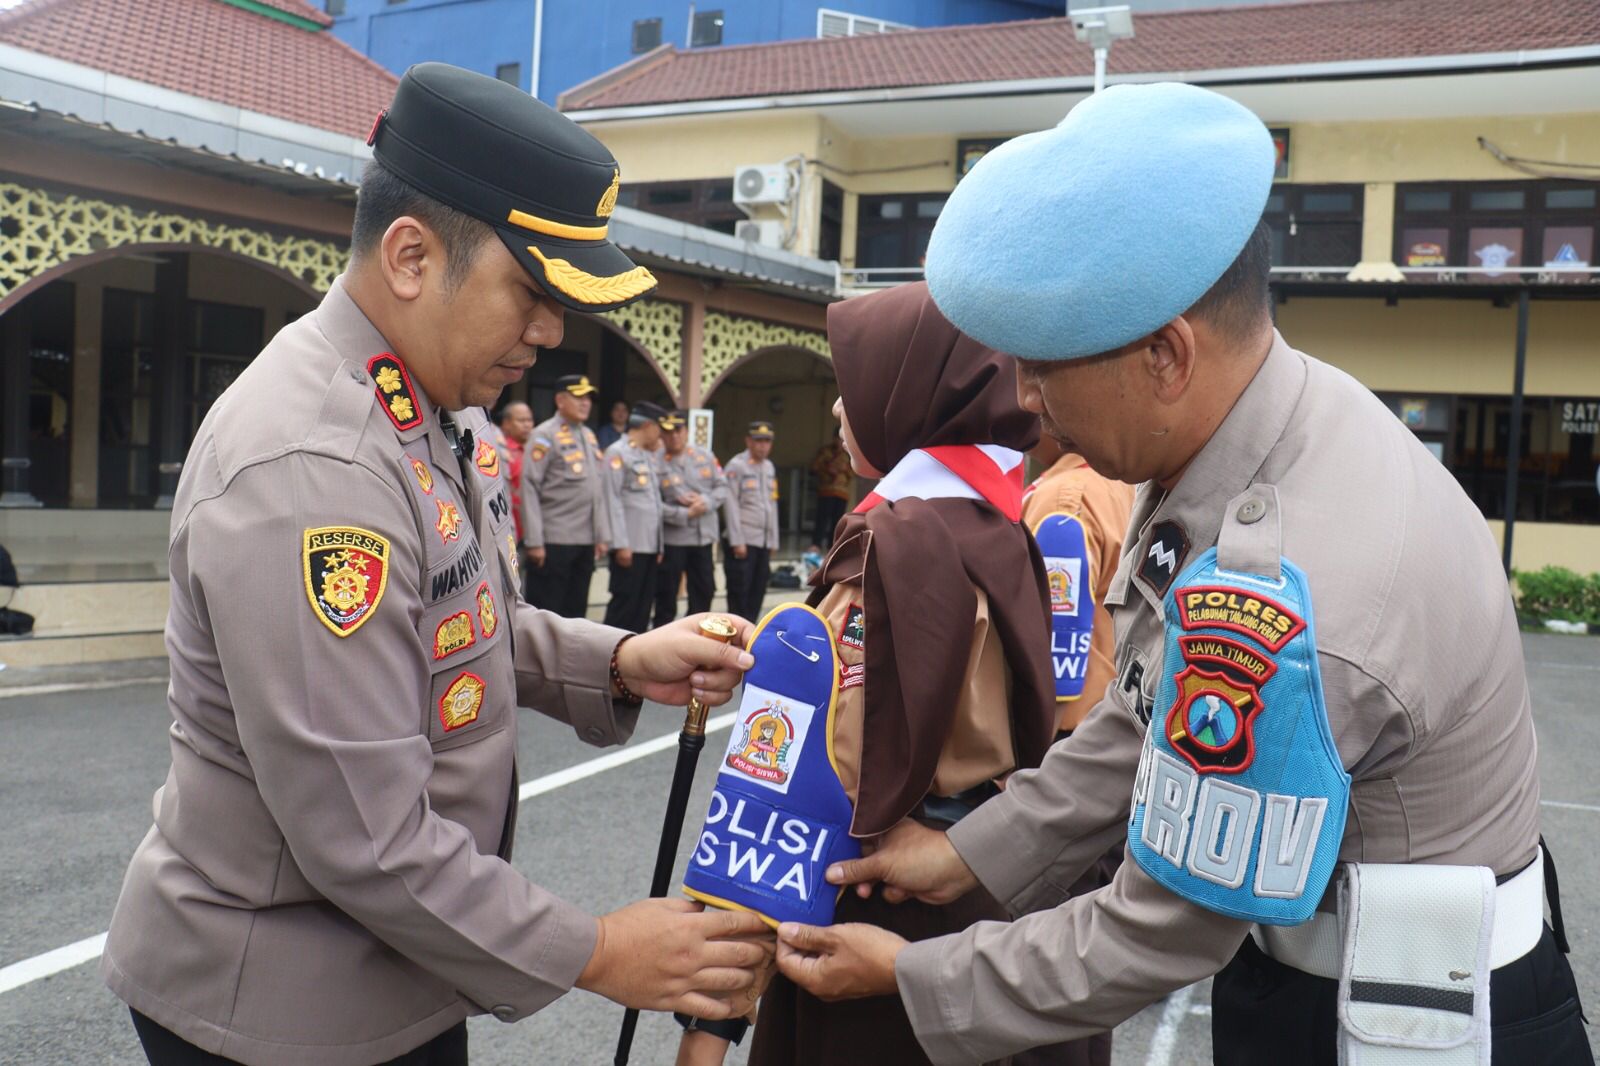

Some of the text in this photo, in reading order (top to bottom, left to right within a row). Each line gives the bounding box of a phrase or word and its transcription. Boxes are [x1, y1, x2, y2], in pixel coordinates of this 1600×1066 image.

[1563, 402, 1600, 420] SAT
[311, 532, 383, 555] RESERSE
[431, 545, 479, 601] WAHYU
[1187, 591, 1293, 633] POLRES
[1188, 607, 1229, 622] PELABUHAN
[1256, 622, 1282, 644] PERAK
[444, 637, 466, 654] POLRI
[1188, 641, 1266, 676] JAWA TIMUR
